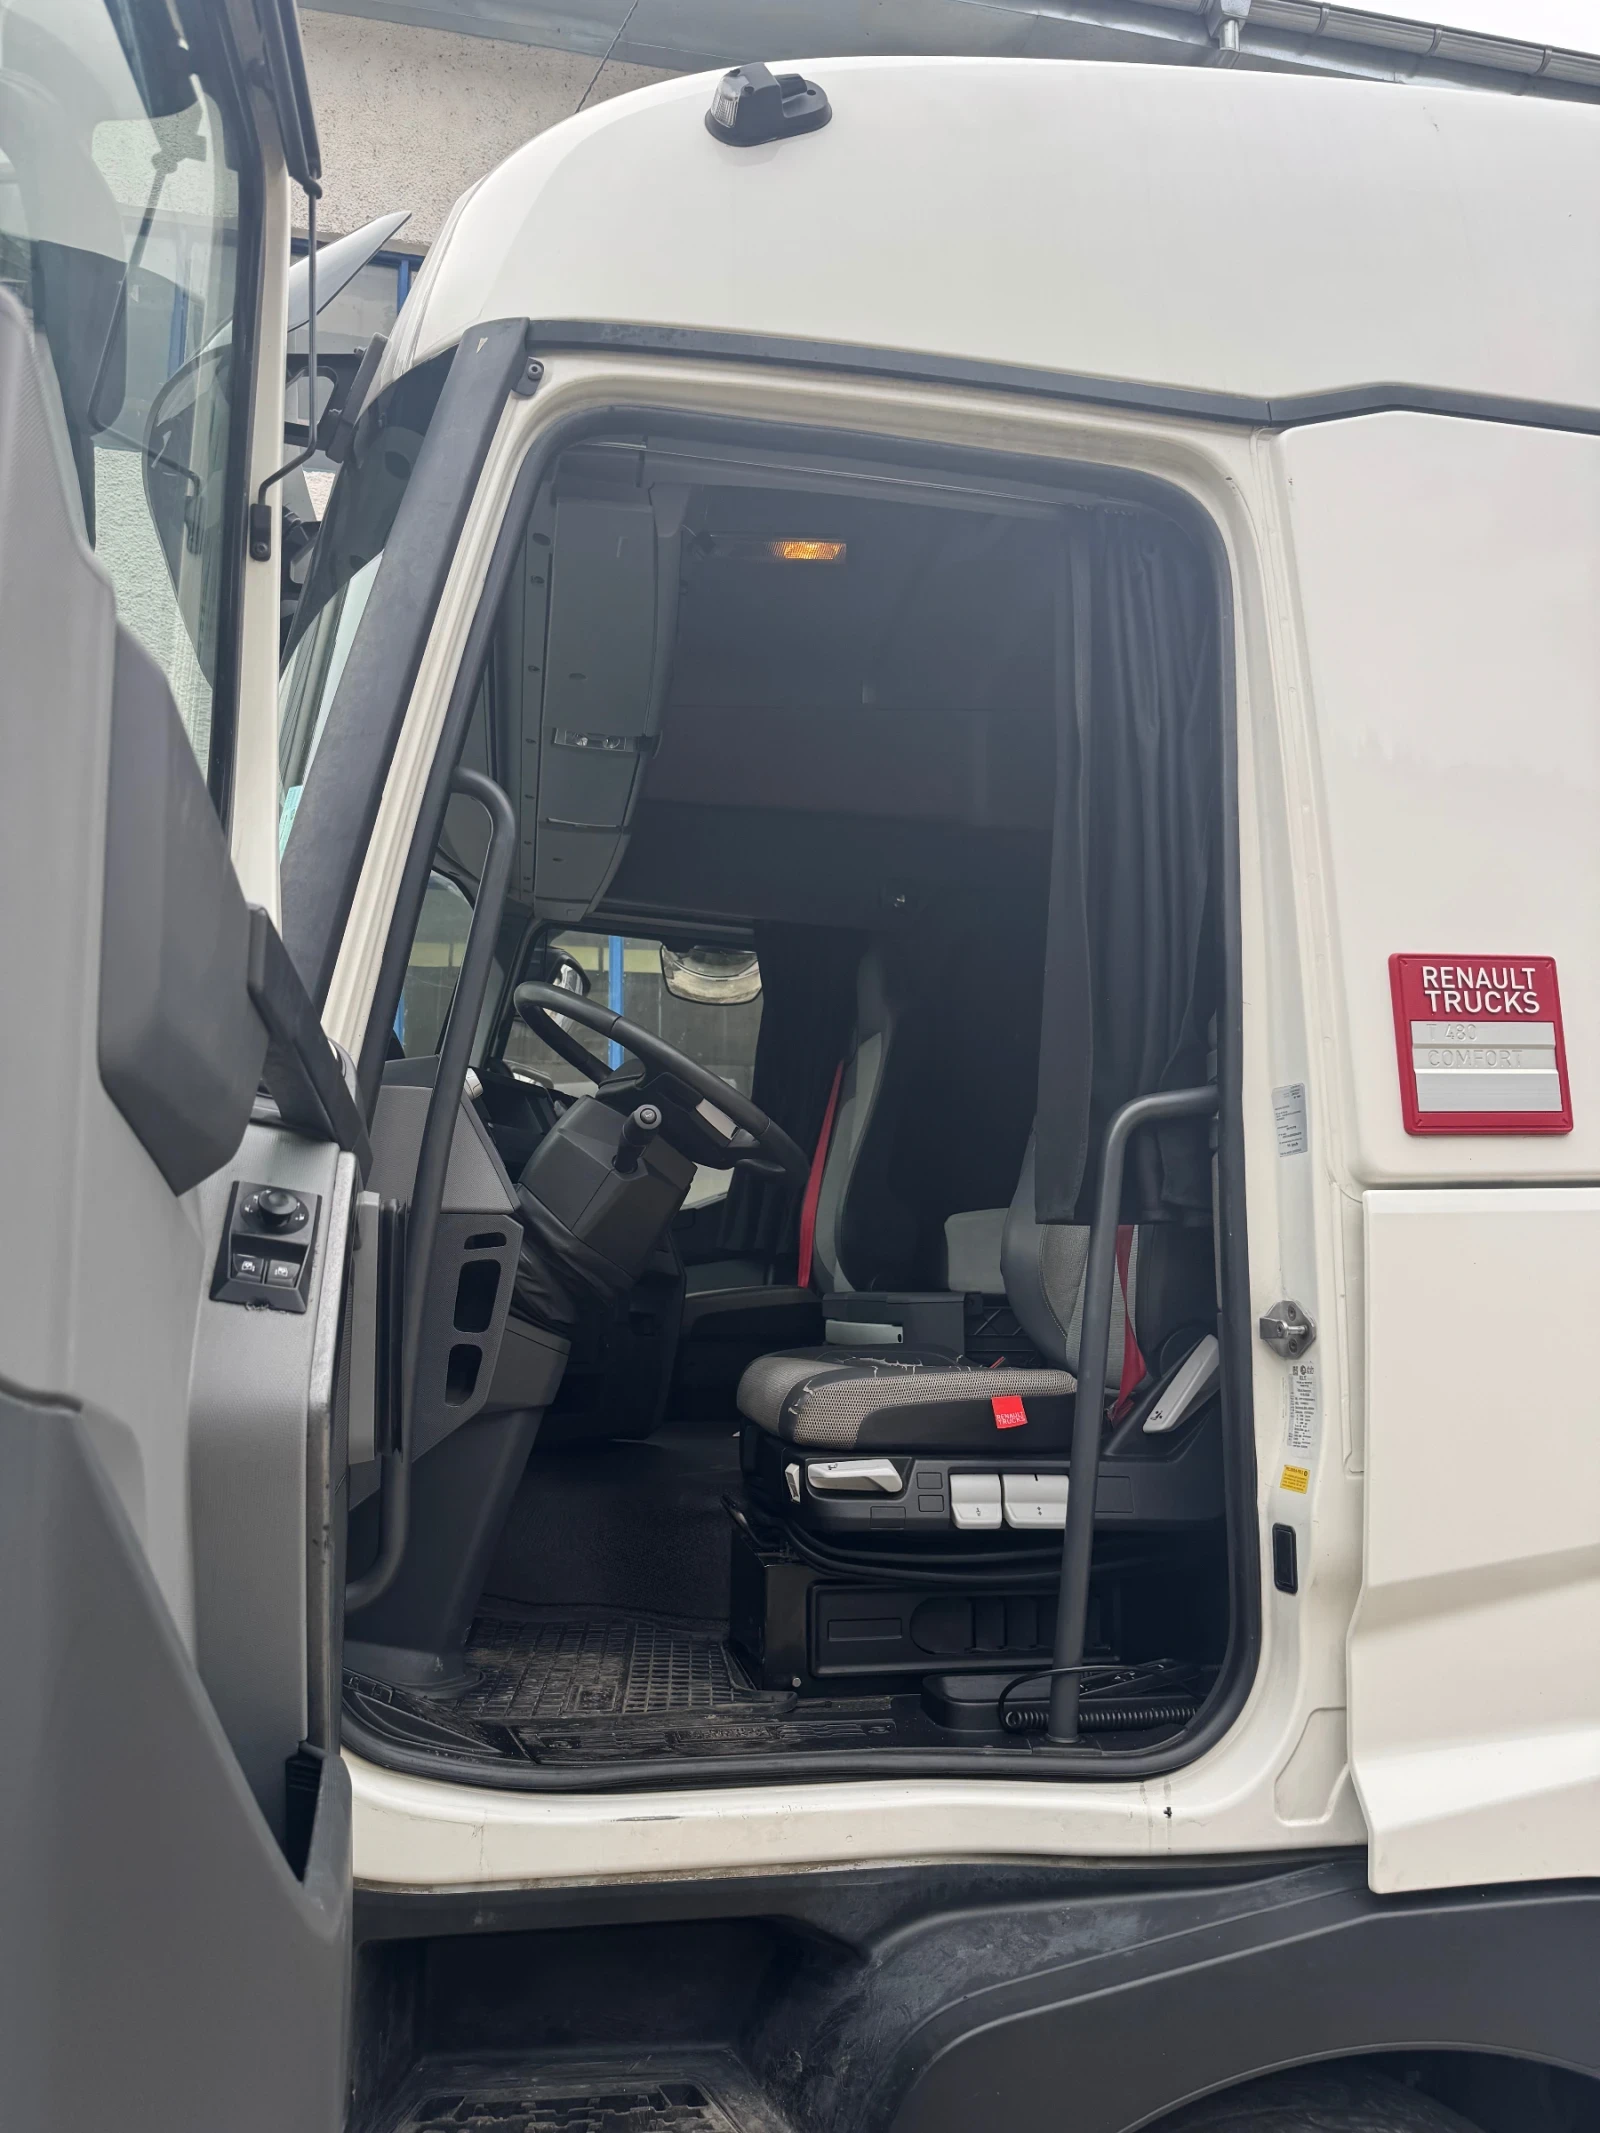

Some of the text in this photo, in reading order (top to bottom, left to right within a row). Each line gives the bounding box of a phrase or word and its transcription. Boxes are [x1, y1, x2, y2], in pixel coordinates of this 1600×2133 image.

[1422, 966, 1535, 989] RENAULT
[1425, 990, 1540, 1013] TRUCKS
[1426, 1023, 1478, 1041] T 480
[1428, 1049, 1523, 1068] COMFORT
[996, 1411, 1023, 1420] RENAULT
[998, 1417, 1026, 1425] TRUCKS
